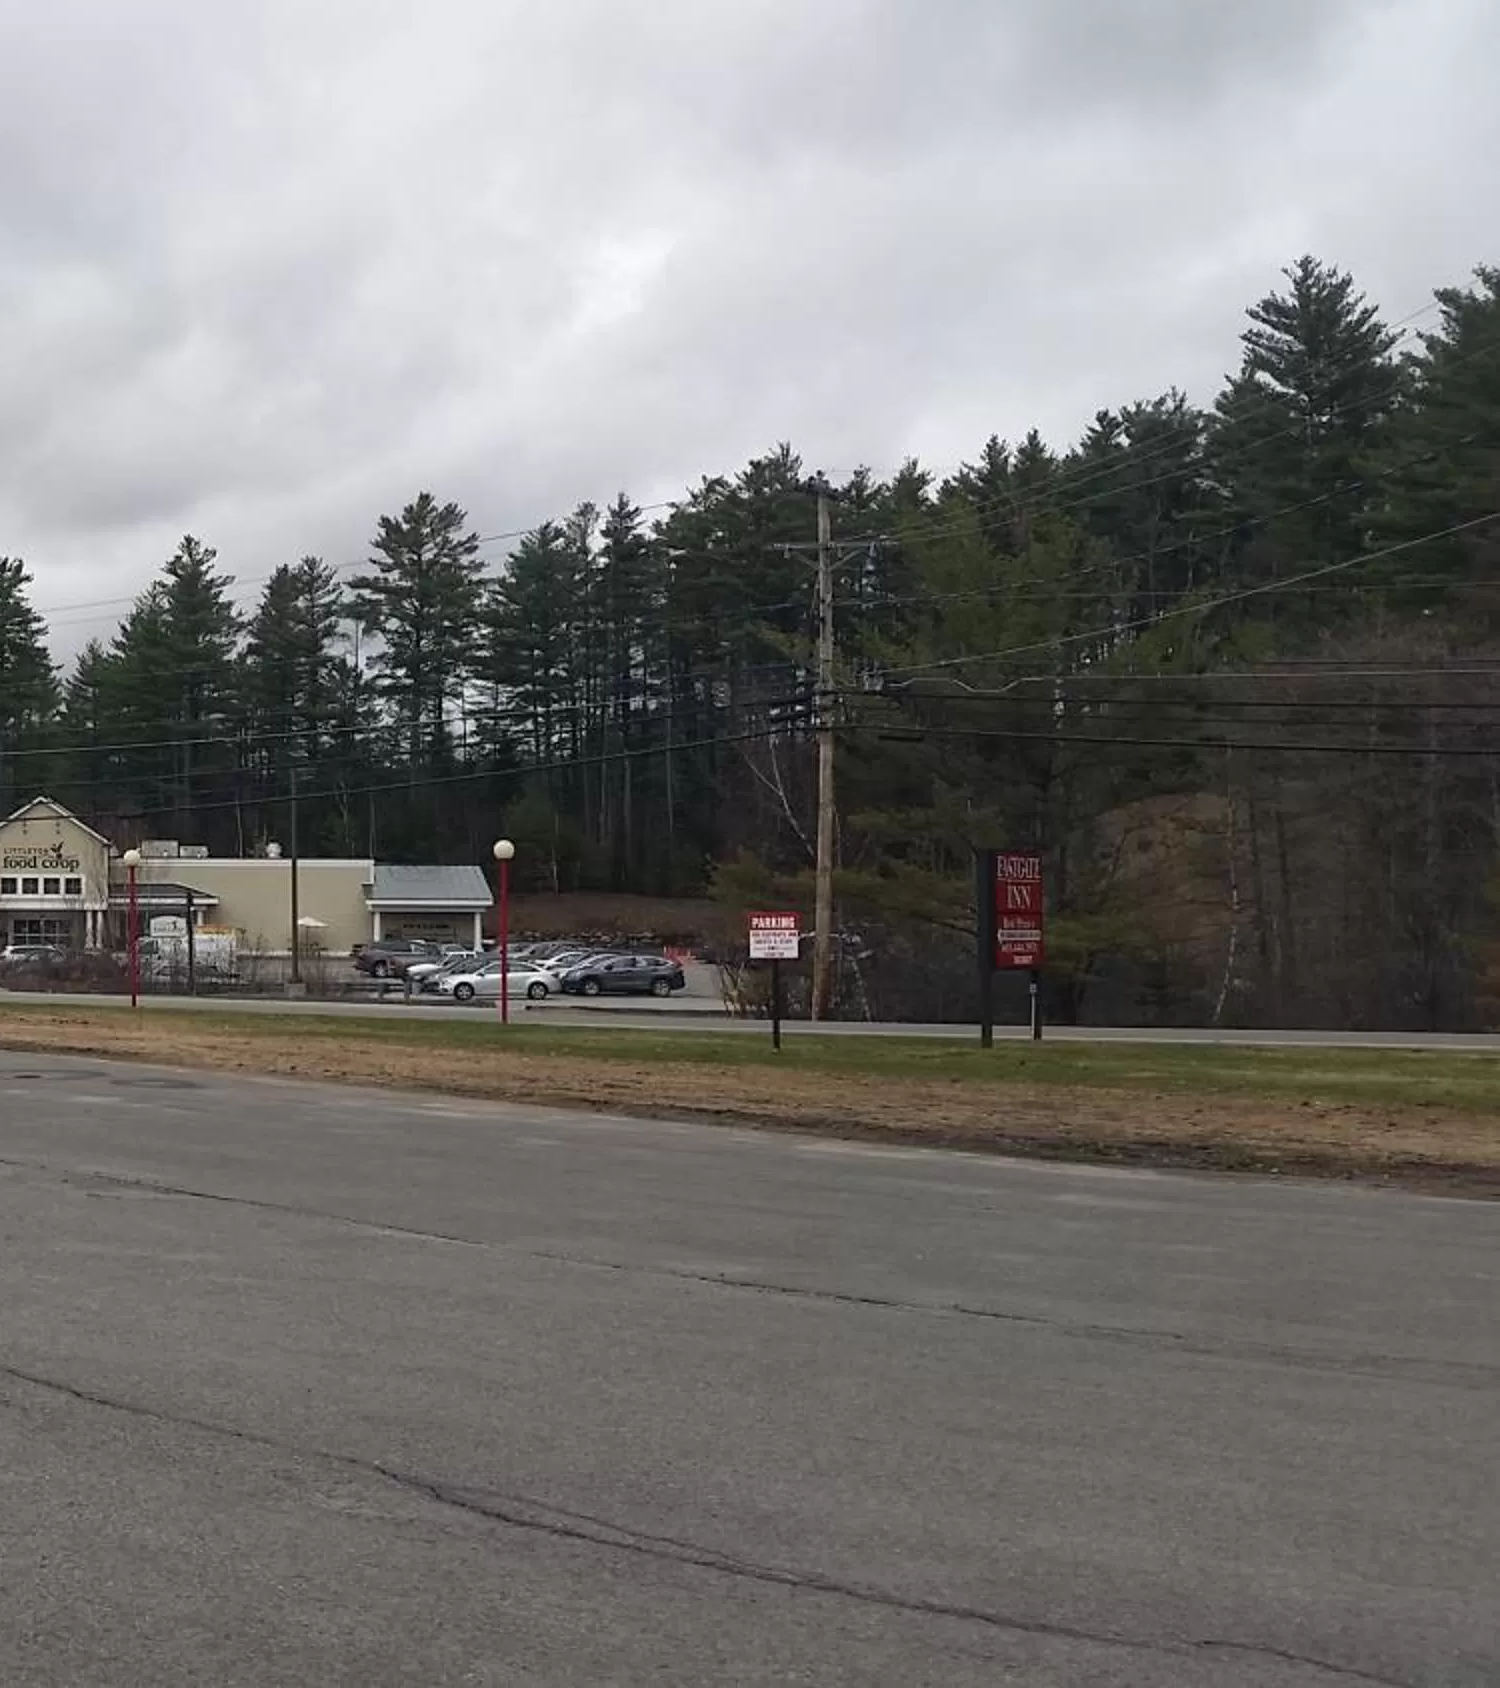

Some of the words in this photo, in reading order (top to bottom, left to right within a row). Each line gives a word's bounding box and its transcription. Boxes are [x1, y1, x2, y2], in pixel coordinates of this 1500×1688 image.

[3, 855, 38, 869] food
[997, 855, 1041, 879] EASTGATE
[1007, 884, 1031, 909] INN
[751, 916, 795, 929] PARKING
